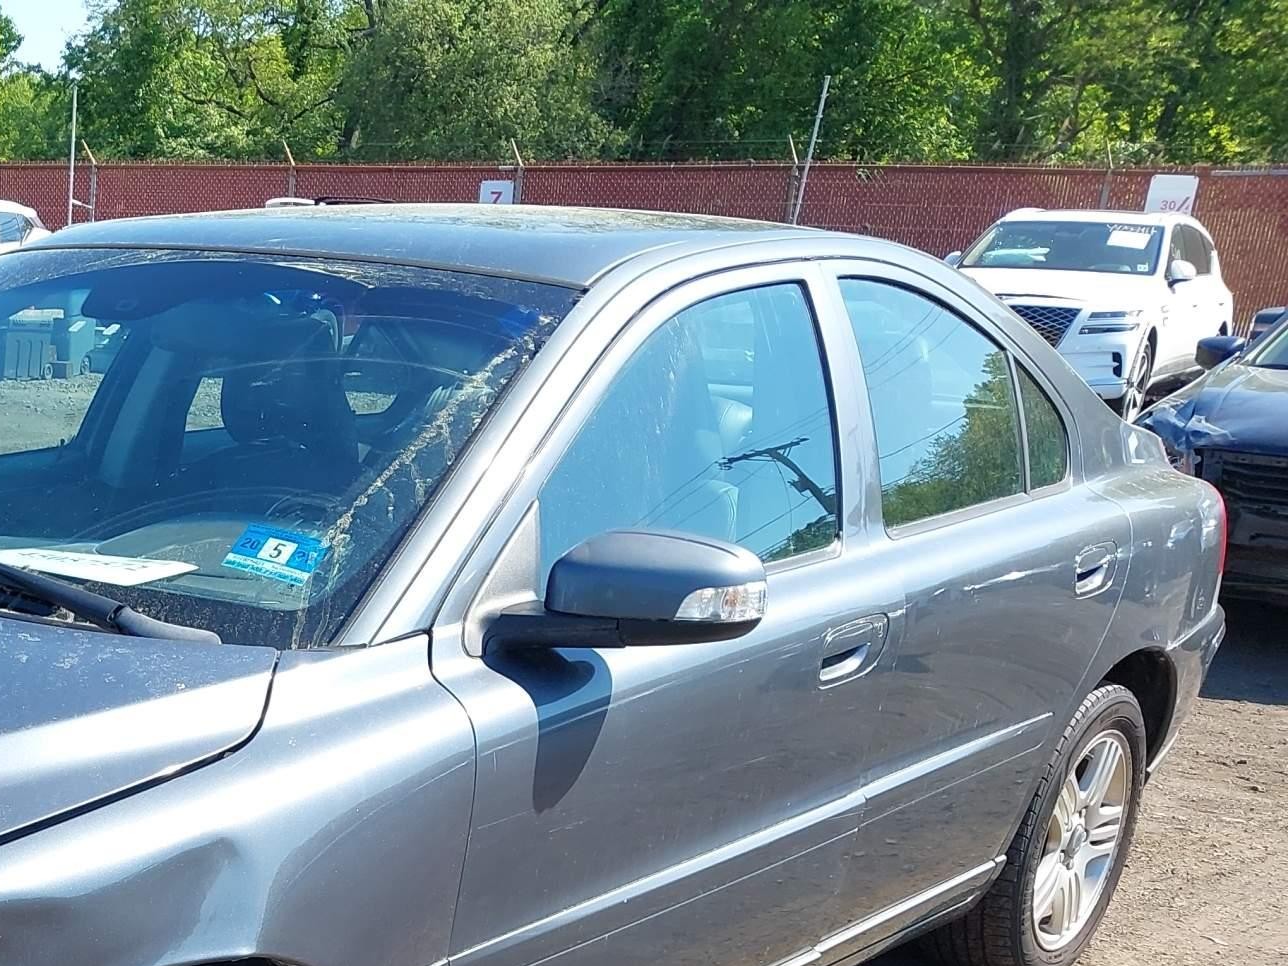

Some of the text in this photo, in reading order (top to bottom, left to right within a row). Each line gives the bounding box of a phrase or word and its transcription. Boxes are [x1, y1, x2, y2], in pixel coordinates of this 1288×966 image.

[490, 191, 503, 204] 7
[240, 536, 261, 550] 20
[269, 542, 288, 559] 5
